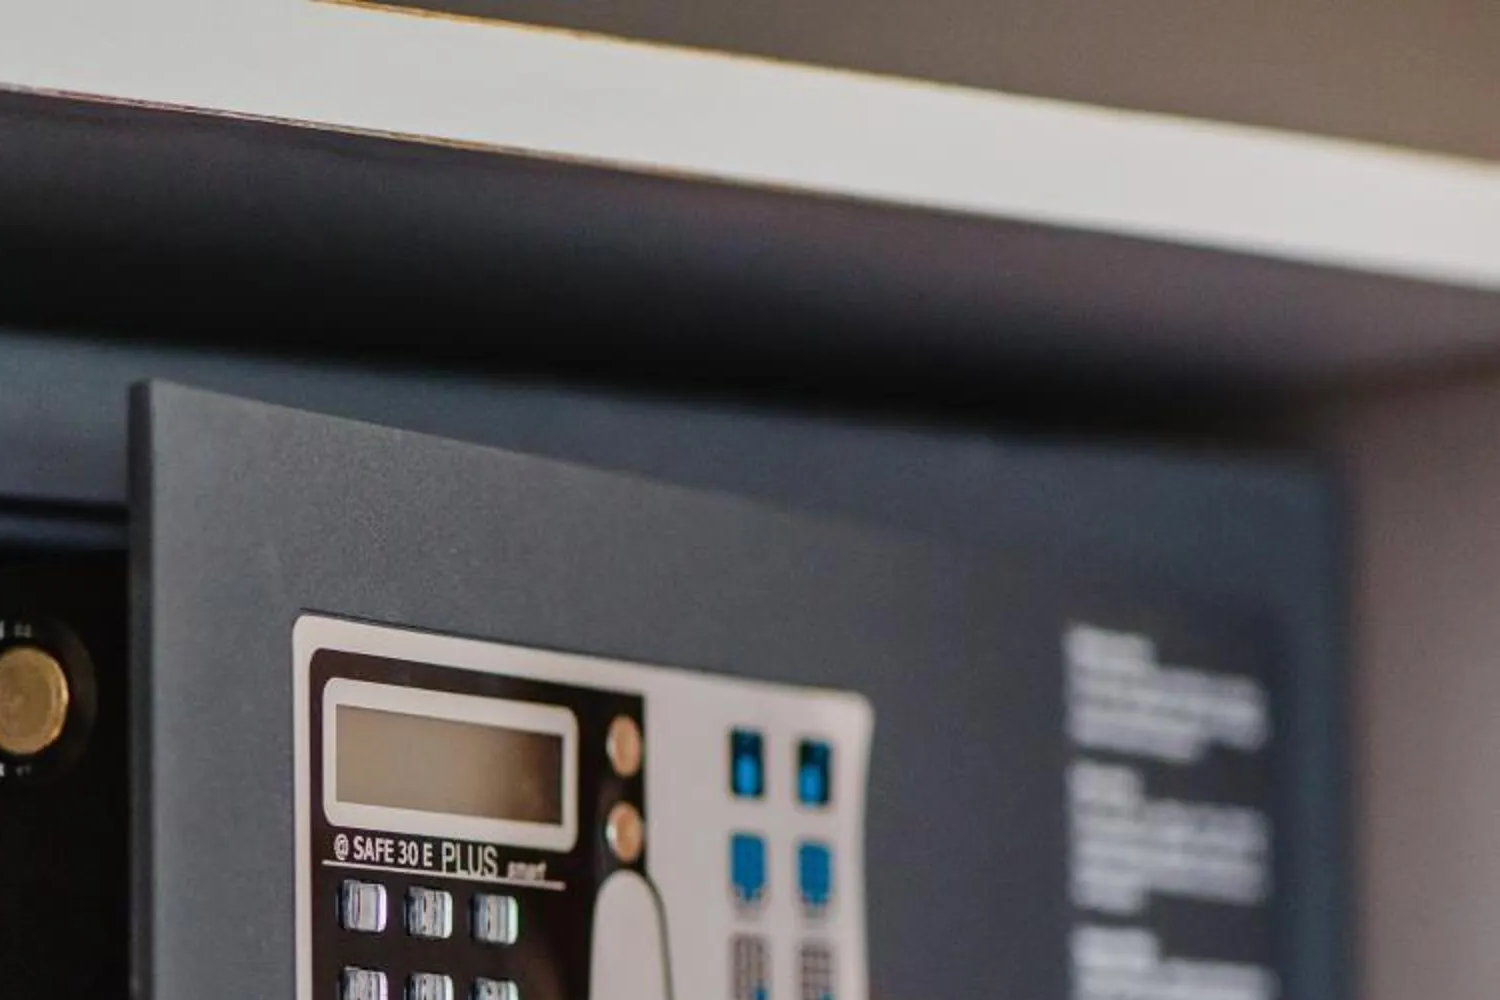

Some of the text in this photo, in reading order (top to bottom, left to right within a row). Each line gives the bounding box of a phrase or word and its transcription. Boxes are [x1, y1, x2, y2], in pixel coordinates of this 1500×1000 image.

[353, 834, 395, 864] SAFE
[399, 841, 418, 867] 30
[422, 842, 434, 868] E
[441, 841, 498, 879] PLUS
